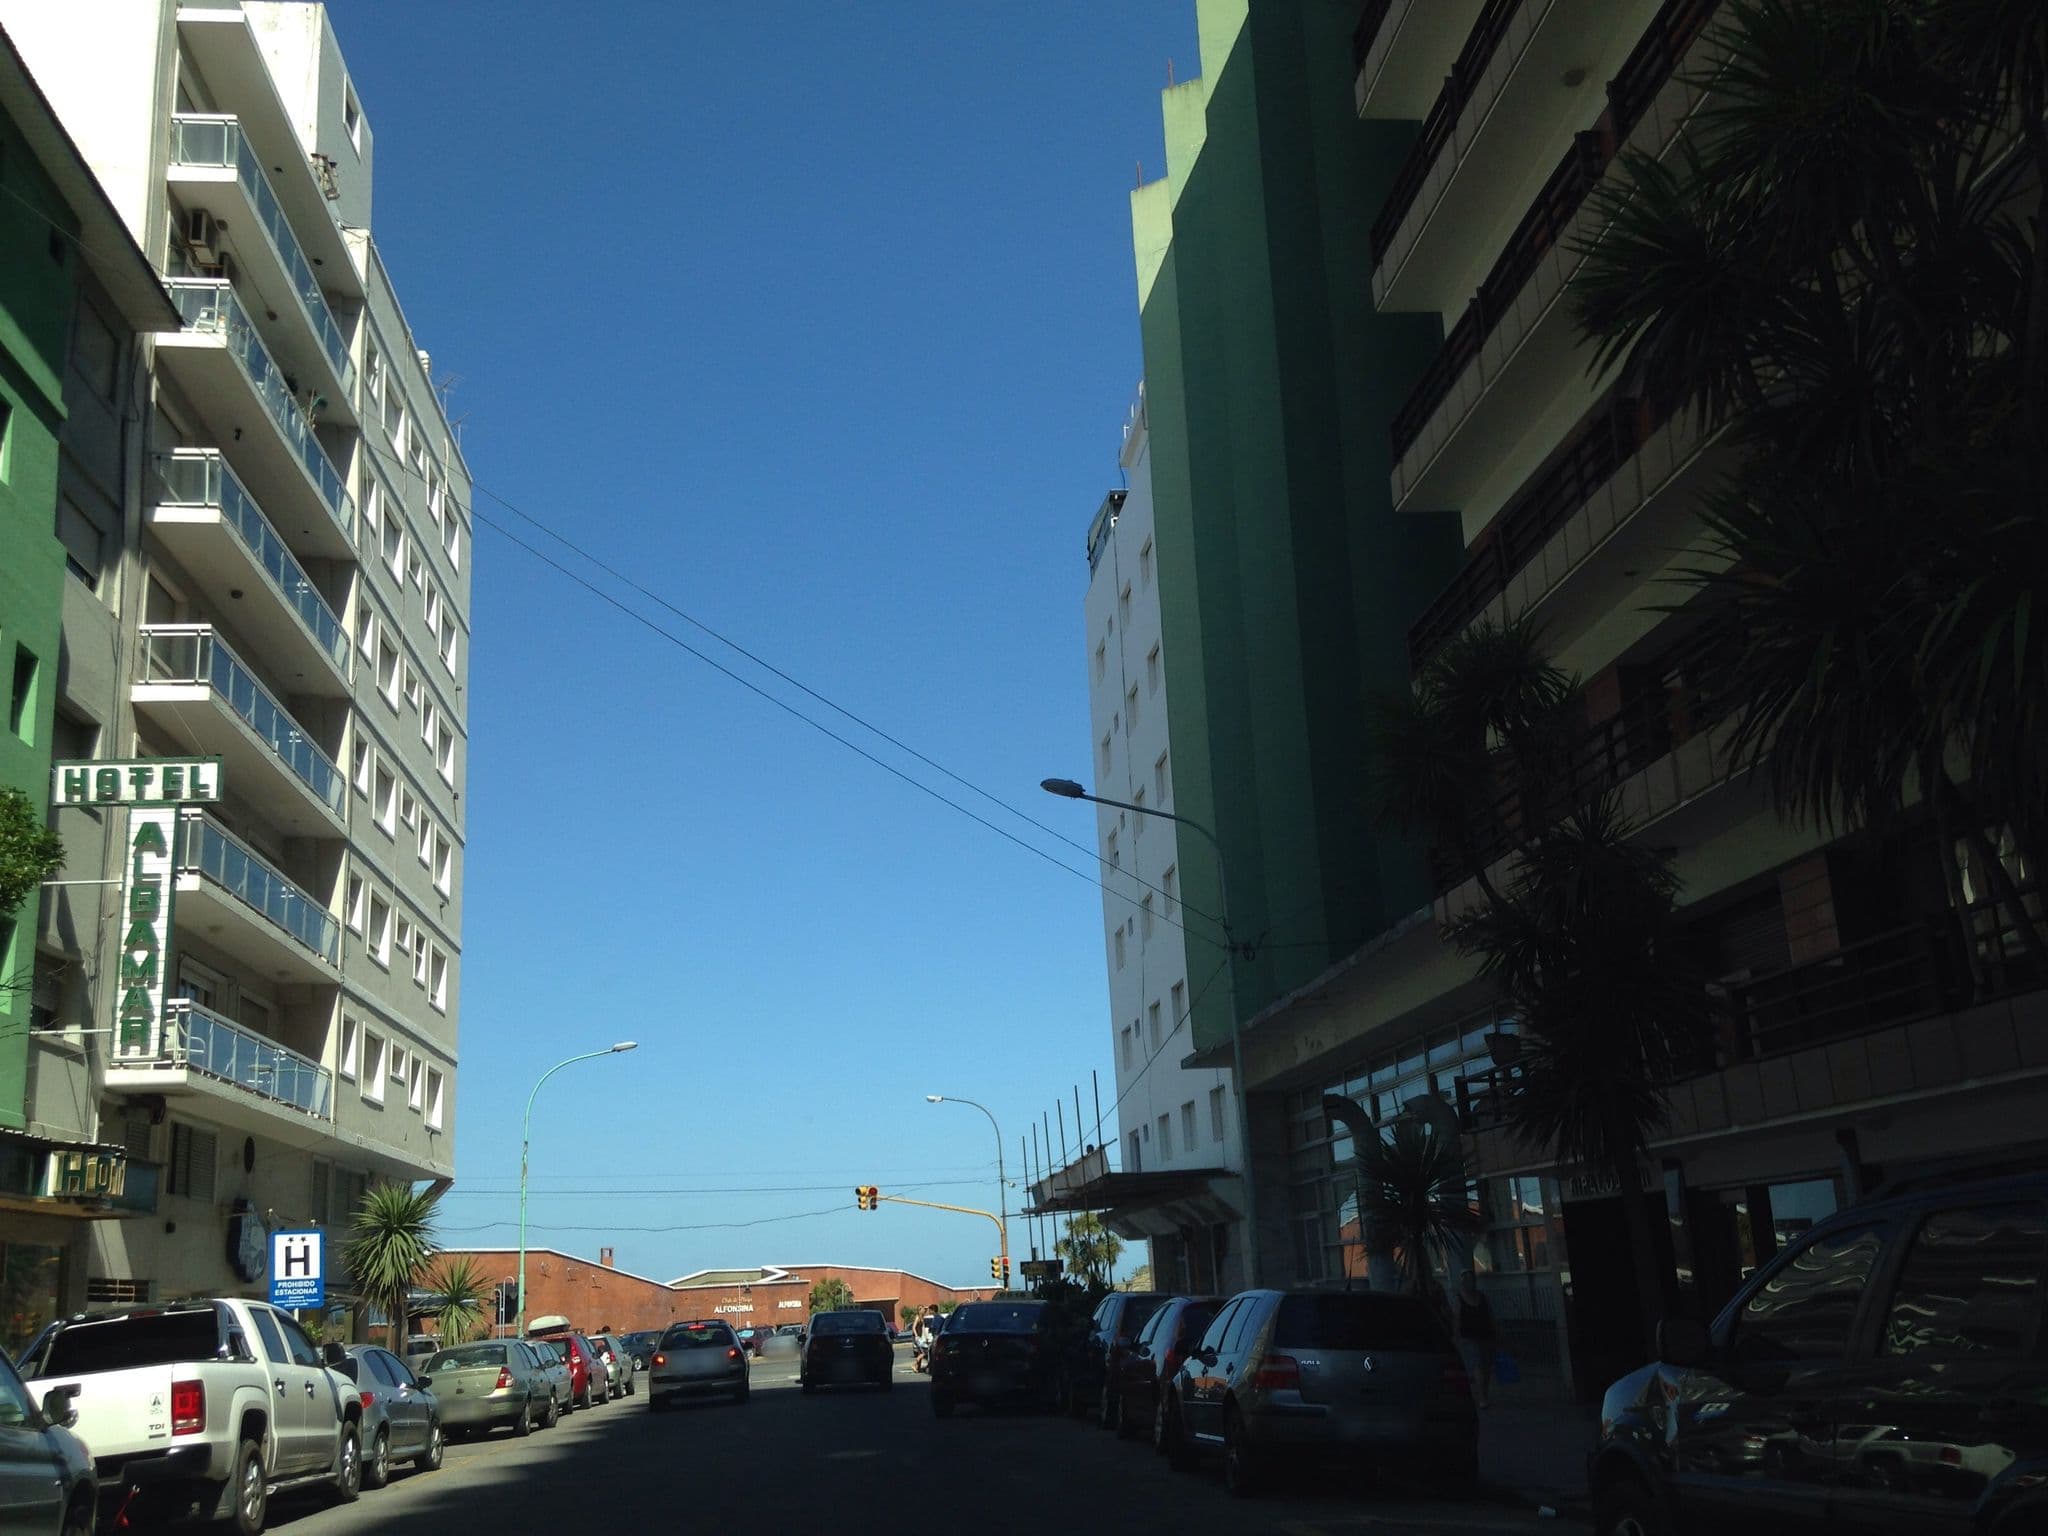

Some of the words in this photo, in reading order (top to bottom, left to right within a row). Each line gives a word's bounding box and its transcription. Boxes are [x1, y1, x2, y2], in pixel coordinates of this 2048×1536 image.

[65, 766, 211, 800] HOTEL
[121, 821, 169, 1055] ALBAMAR
[285, 1245, 310, 1277] H
[274, 1287, 318, 1296] ESTACIONAR
[278, 1280, 316, 1288] PROHIBIDO
[714, 1304, 754, 1313] ALFONSINA
